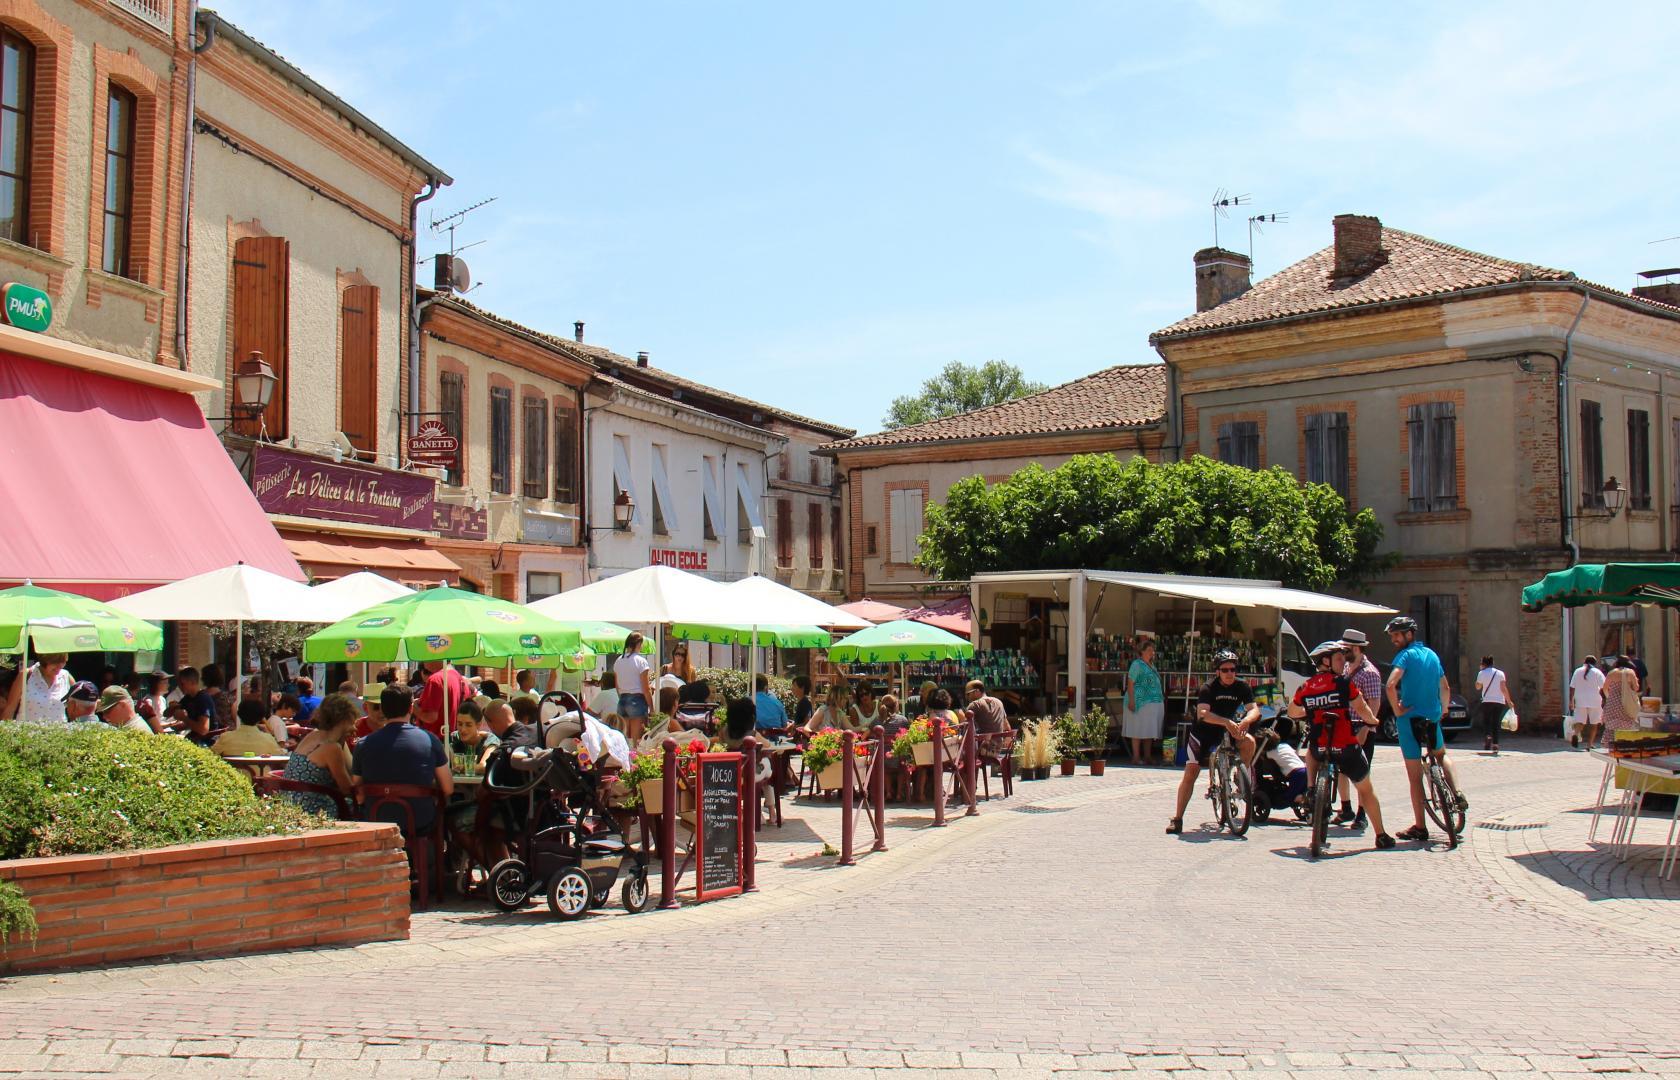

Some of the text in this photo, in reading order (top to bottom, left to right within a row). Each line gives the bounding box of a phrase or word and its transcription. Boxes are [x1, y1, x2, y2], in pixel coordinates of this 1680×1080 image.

[9, 297, 35, 316] PMU
[412, 440, 453, 449] BANETTE
[255, 462, 292, 498] Pâtisserie
[285, 469, 401, 509] Les Délices de la Fontaine
[651, 549, 708, 569] AUTO ECOLE
[1305, 693, 1339, 706] BMC
